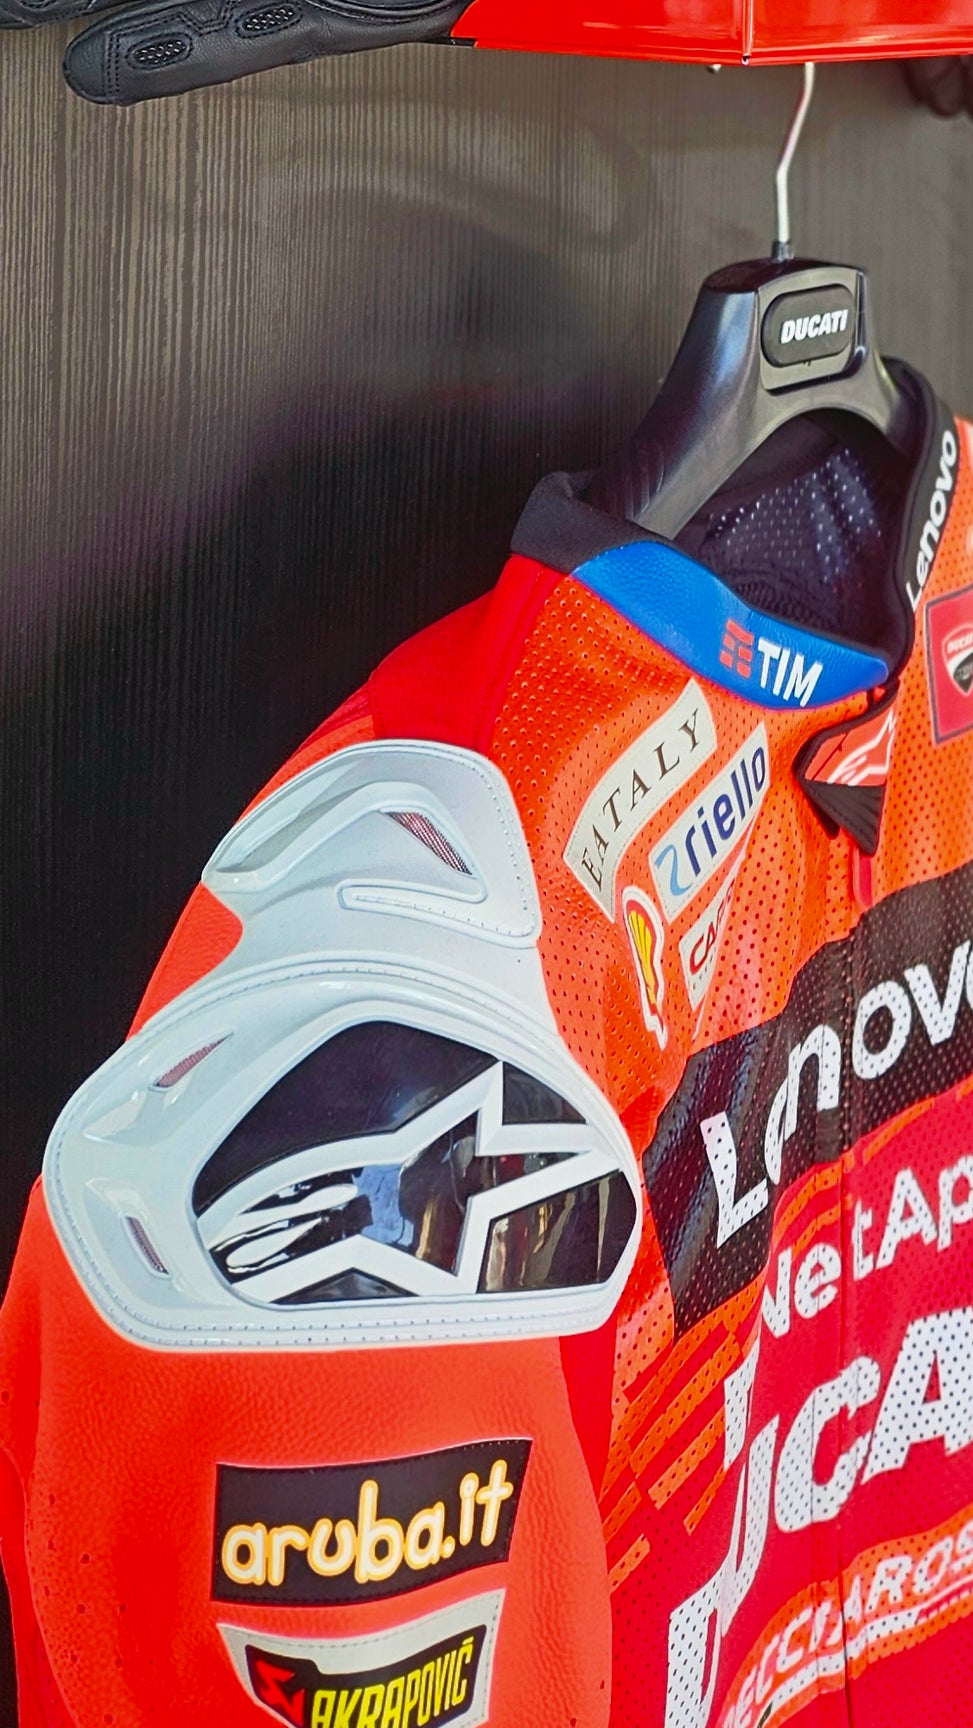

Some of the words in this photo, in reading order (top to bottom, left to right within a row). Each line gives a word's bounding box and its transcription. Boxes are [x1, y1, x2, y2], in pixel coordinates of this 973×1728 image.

[780, 309, 849, 344] DUCATI
[905, 430, 957, 613] Lenovo
[758, 636, 824, 708] TIM
[581, 708, 700, 892] EATALY
[685, 746, 766, 877] riello
[221, 1460, 513, 1587] aruba.it
